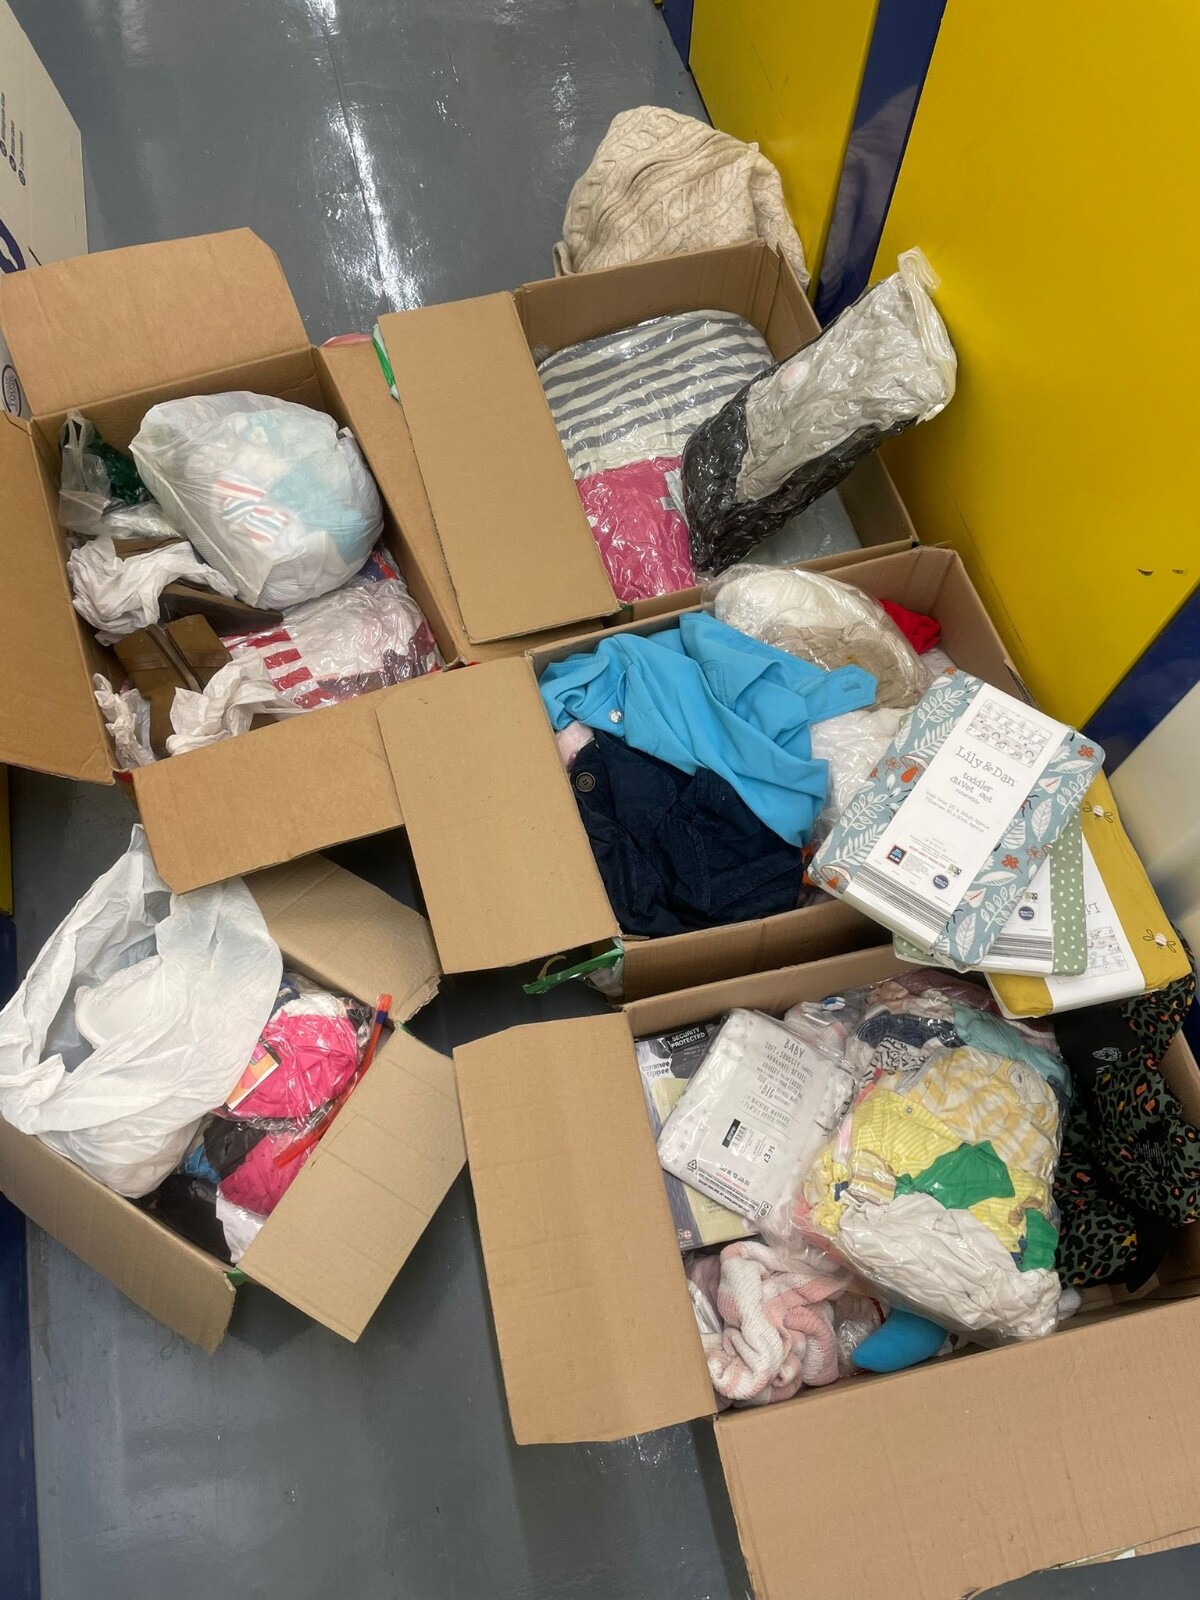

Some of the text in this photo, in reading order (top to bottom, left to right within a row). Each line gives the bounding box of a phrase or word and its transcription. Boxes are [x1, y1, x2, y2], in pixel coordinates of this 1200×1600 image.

[950, 776, 974, 793] duvet
[963, 772, 993, 792] toddler
[670, 1032, 705, 1048] PROTECTED
[672, 1028, 699, 1041] SECURITY
[784, 1039, 805, 1058] BABY
[642, 1061, 670, 1071] tommee
[647, 1066, 669, 1077] tippee
[761, 1084, 775, 1098] BIG
